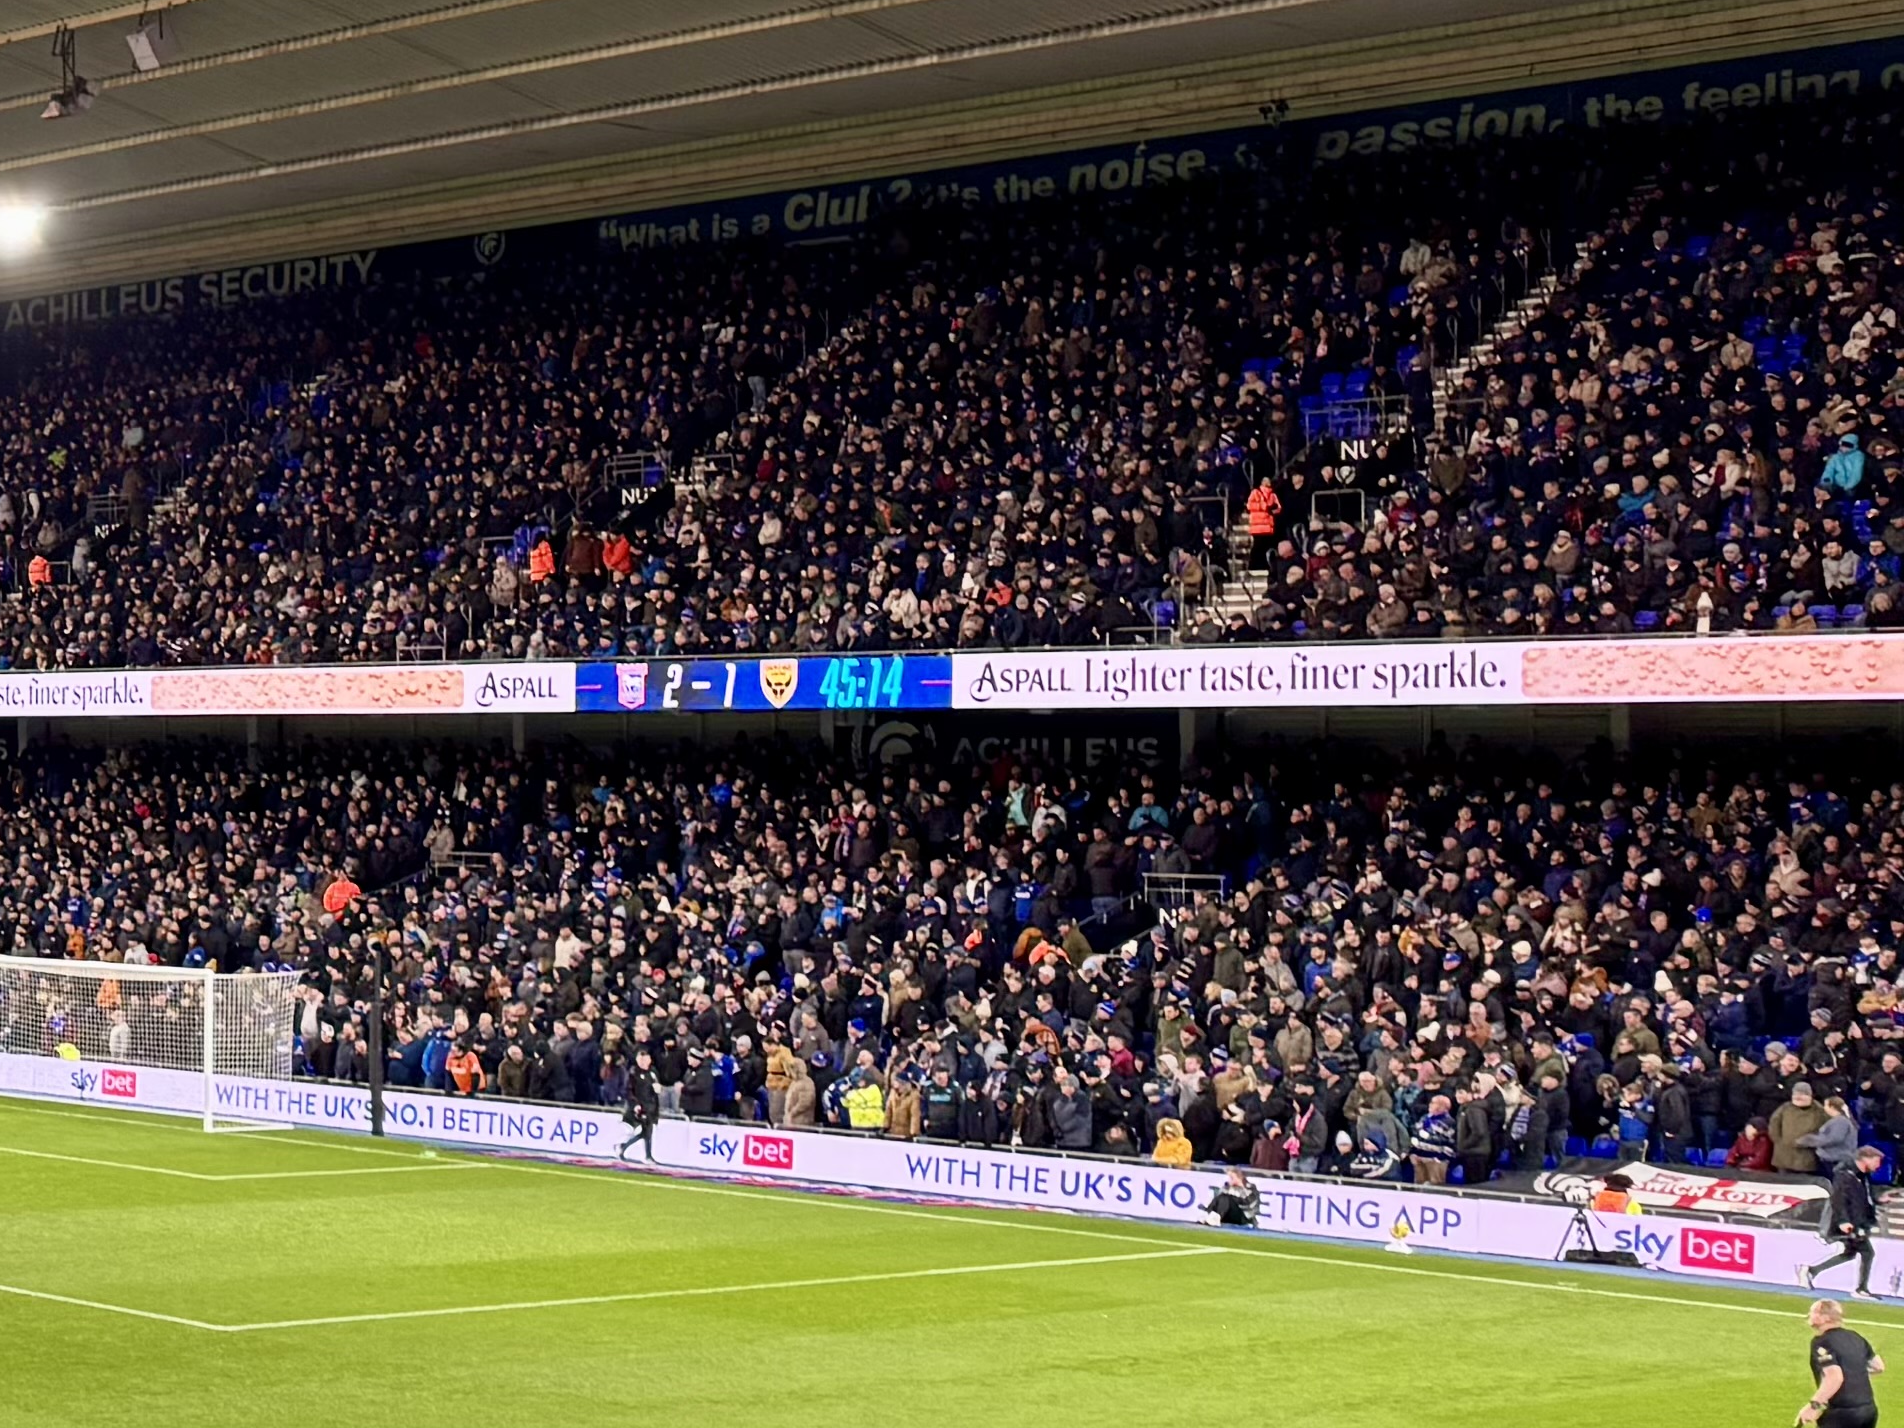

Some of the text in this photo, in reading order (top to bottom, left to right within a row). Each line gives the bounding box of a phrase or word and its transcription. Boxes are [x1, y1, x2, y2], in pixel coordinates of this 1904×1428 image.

[711, 213, 738, 240] is
[994, 168, 1055, 204] the
[1583, 94, 1663, 129] the
[199, 252, 377, 304] SECURITY
[29, 678, 71, 705] finer
[72, 675, 143, 710] sparkle.
[475, 671, 559, 707] ASPALL
[662, 663, 683, 708] 2
[723, 663, 737, 708] 1
[819, 655, 904, 708] 45:14
[969, 649, 1507, 703] ASPALL Lighter taste, finer sparkle.
[70, 1067, 135, 1093] sky bet
[215, 1083, 599, 1147] WITH THE UK'S NO.1 BETTING APP
[699, 1133, 791, 1166] sky bet
[905, 1154, 982, 1188] WITH
[990, 1161, 1048, 1194] THE
[1060, 1169, 1133, 1202] UK'S
[1144, 1179, 1203, 1211] NO.
[1391, 1204, 1462, 1239] APP
[1710, 1185, 1788, 1206] LOYAL
[1615, 1223, 1750, 1265] sky bet
